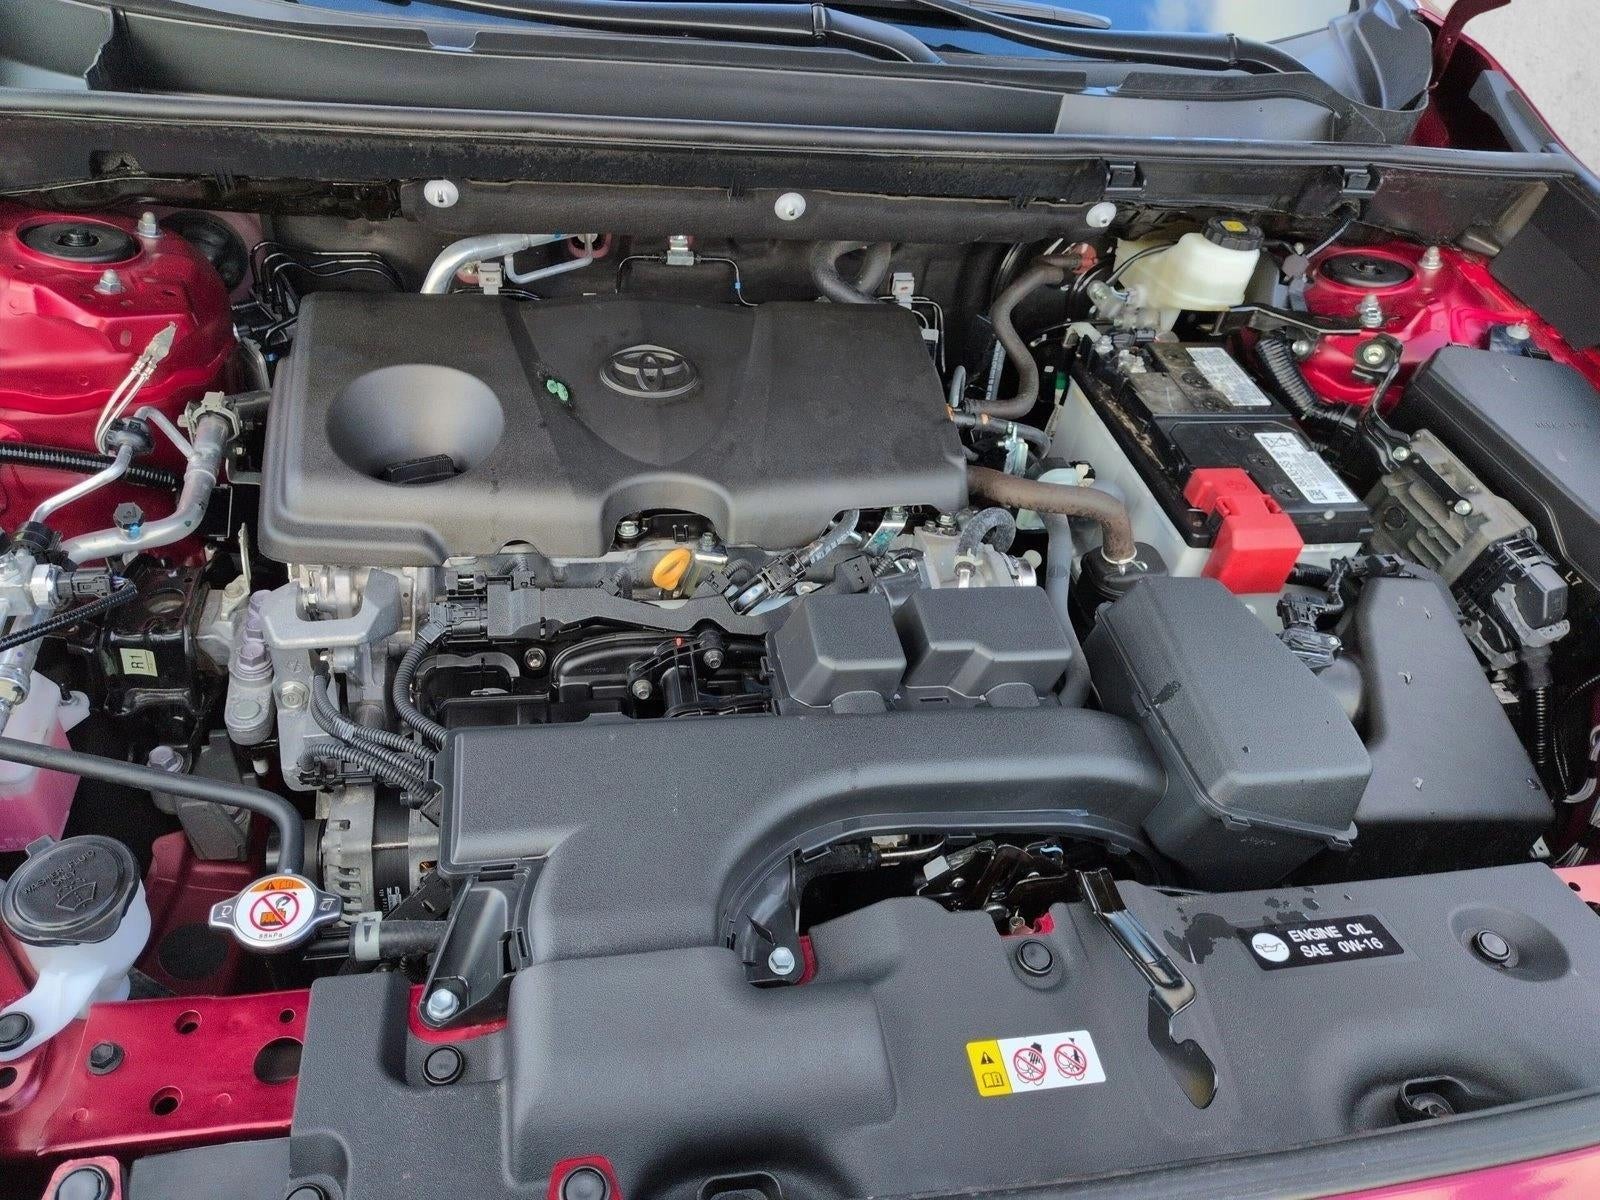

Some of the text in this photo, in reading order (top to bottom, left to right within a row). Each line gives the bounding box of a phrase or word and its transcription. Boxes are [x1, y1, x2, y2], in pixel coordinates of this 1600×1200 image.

[1565, 571, 1583, 586] L7
[129, 655, 144, 668] R1
[24, 849, 96, 894] WASHER FLUID
[51, 869, 76, 887] ONLY
[1287, 922, 1373, 942] ENGINE OIL
[1300, 937, 1384, 958] SAE 0W-16
